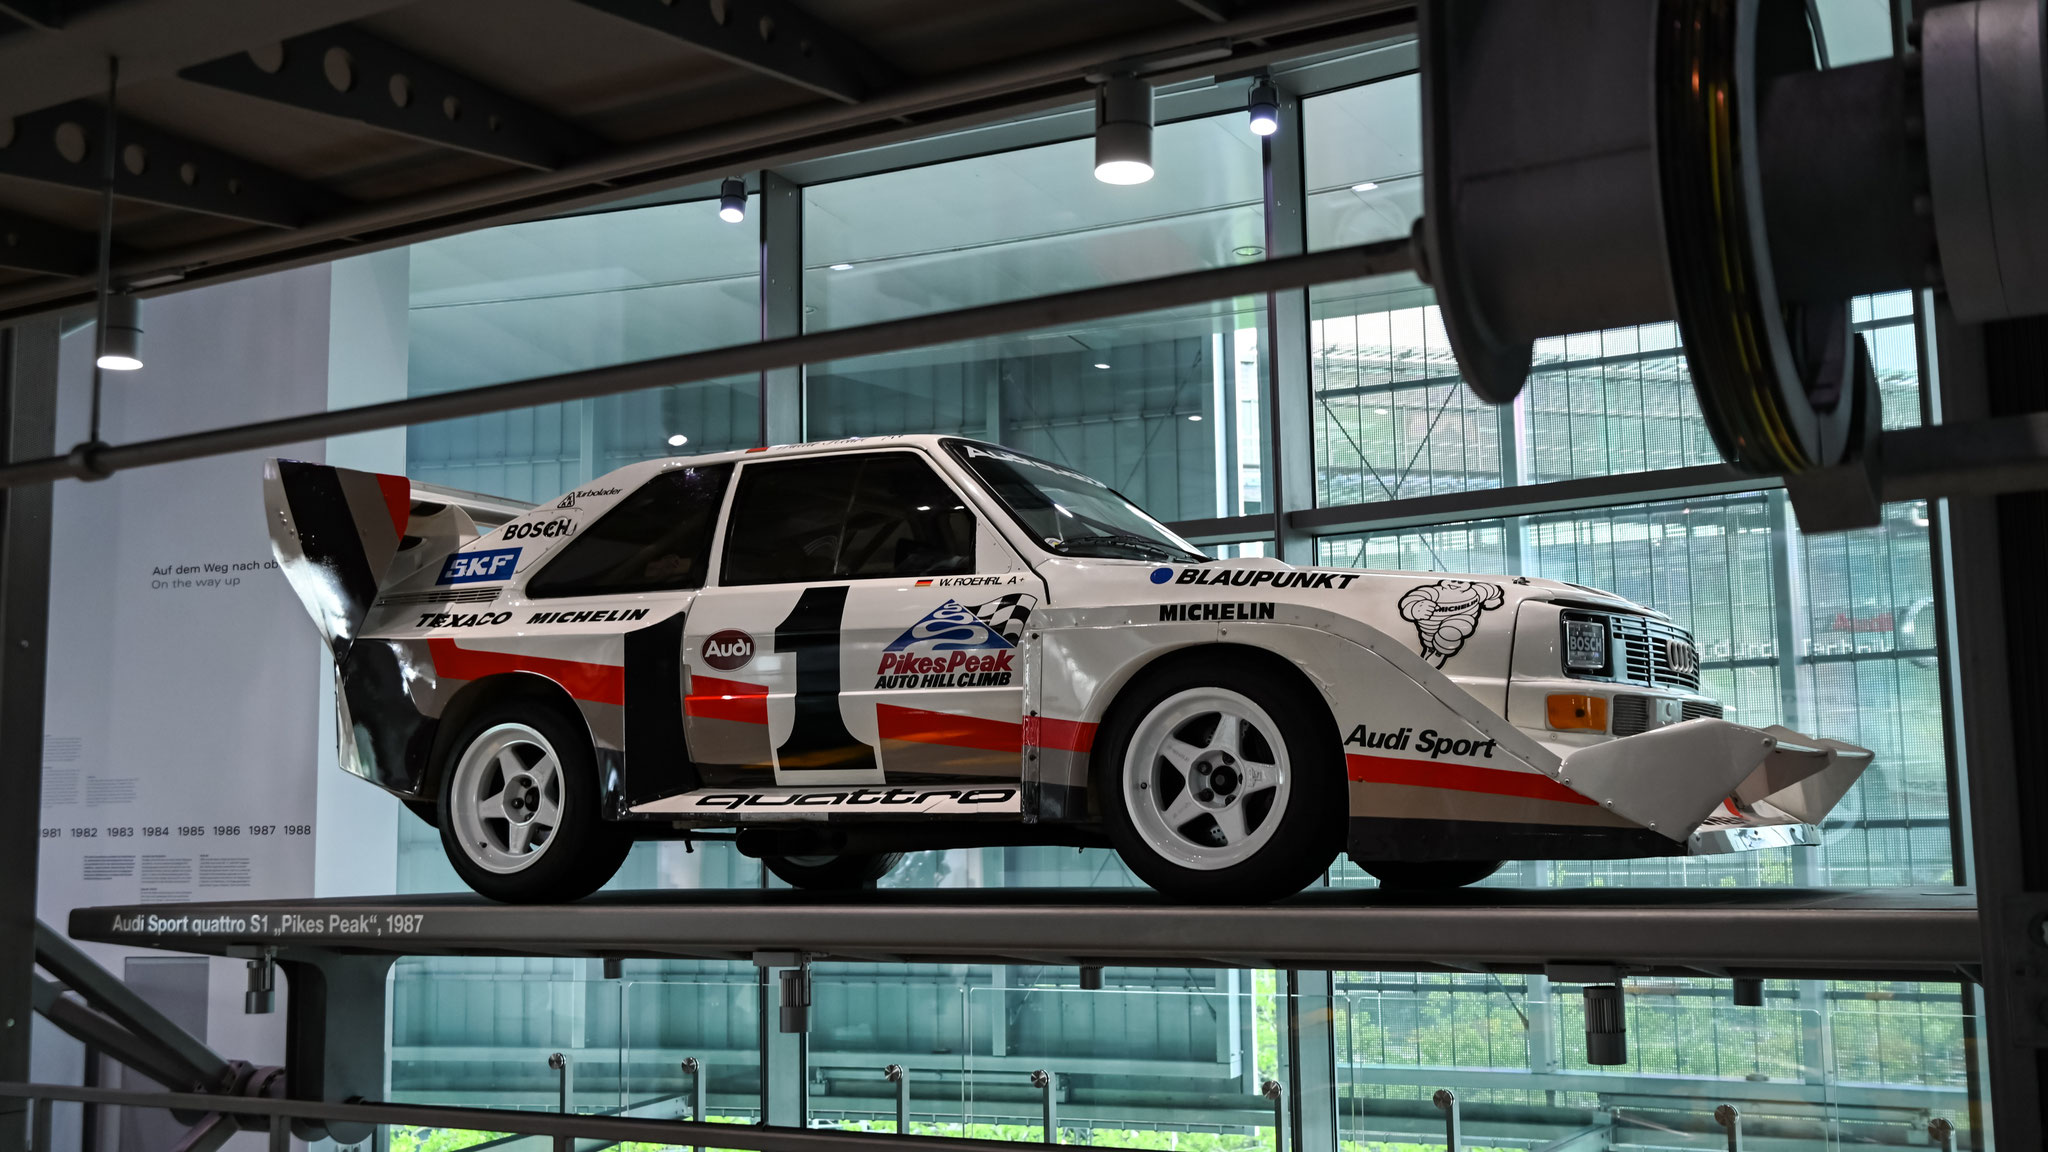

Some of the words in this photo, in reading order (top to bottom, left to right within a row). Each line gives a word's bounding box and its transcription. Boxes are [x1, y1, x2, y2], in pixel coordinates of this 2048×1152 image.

[576, 488, 623, 498] Turbolader
[502, 519, 571, 540] BOSCH
[152, 565, 173, 576] Auf
[176, 563, 201, 575] dem
[204, 562, 229, 574] Weg
[232, 560, 260, 571] nach
[446, 555, 514, 578] SKF
[151, 579, 169, 590] On
[172, 578, 192, 588] the
[195, 577, 222, 588] way
[224, 576, 241, 587] up
[953, 576, 1002, 586] ROEHRL
[1175, 569, 1360, 590] BLAUPUNKT
[1159, 603, 1275, 622] MICHELIN
[1435, 598, 1478, 613] MICHELIN
[415, 612, 513, 628] TEXACO
[526, 608, 650, 624] MICHELIN
[704, 639, 751, 658] Audi
[1570, 636, 1602, 652] BOSCH
[877, 653, 947, 675] Pikes
[946, 650, 1015, 673] Peak
[774, 586, 877, 771] 1
[874, 674, 920, 689] AUTO
[920, 673, 956, 688] HILL
[957, 672, 1012, 687] CLIMB
[1344, 725, 1412, 751] Audi
[1415, 729, 1497, 759] Sport
[695, 789, 1017, 810] quattro
[71, 828, 98, 838] 1982
[107, 827, 134, 837] 1983
[142, 827, 169, 837] 1984
[178, 826, 205, 837] 1985
[213, 826, 241, 836] 1986
[249, 825, 276, 836] 1987
[284, 825, 311, 836] 1988
[112, 914, 145, 932] Audi
[148, 914, 188, 935] Sport
[191, 914, 247, 935] quattro
[250, 915, 269, 933] S1
[387, 914, 424, 934] 1987
